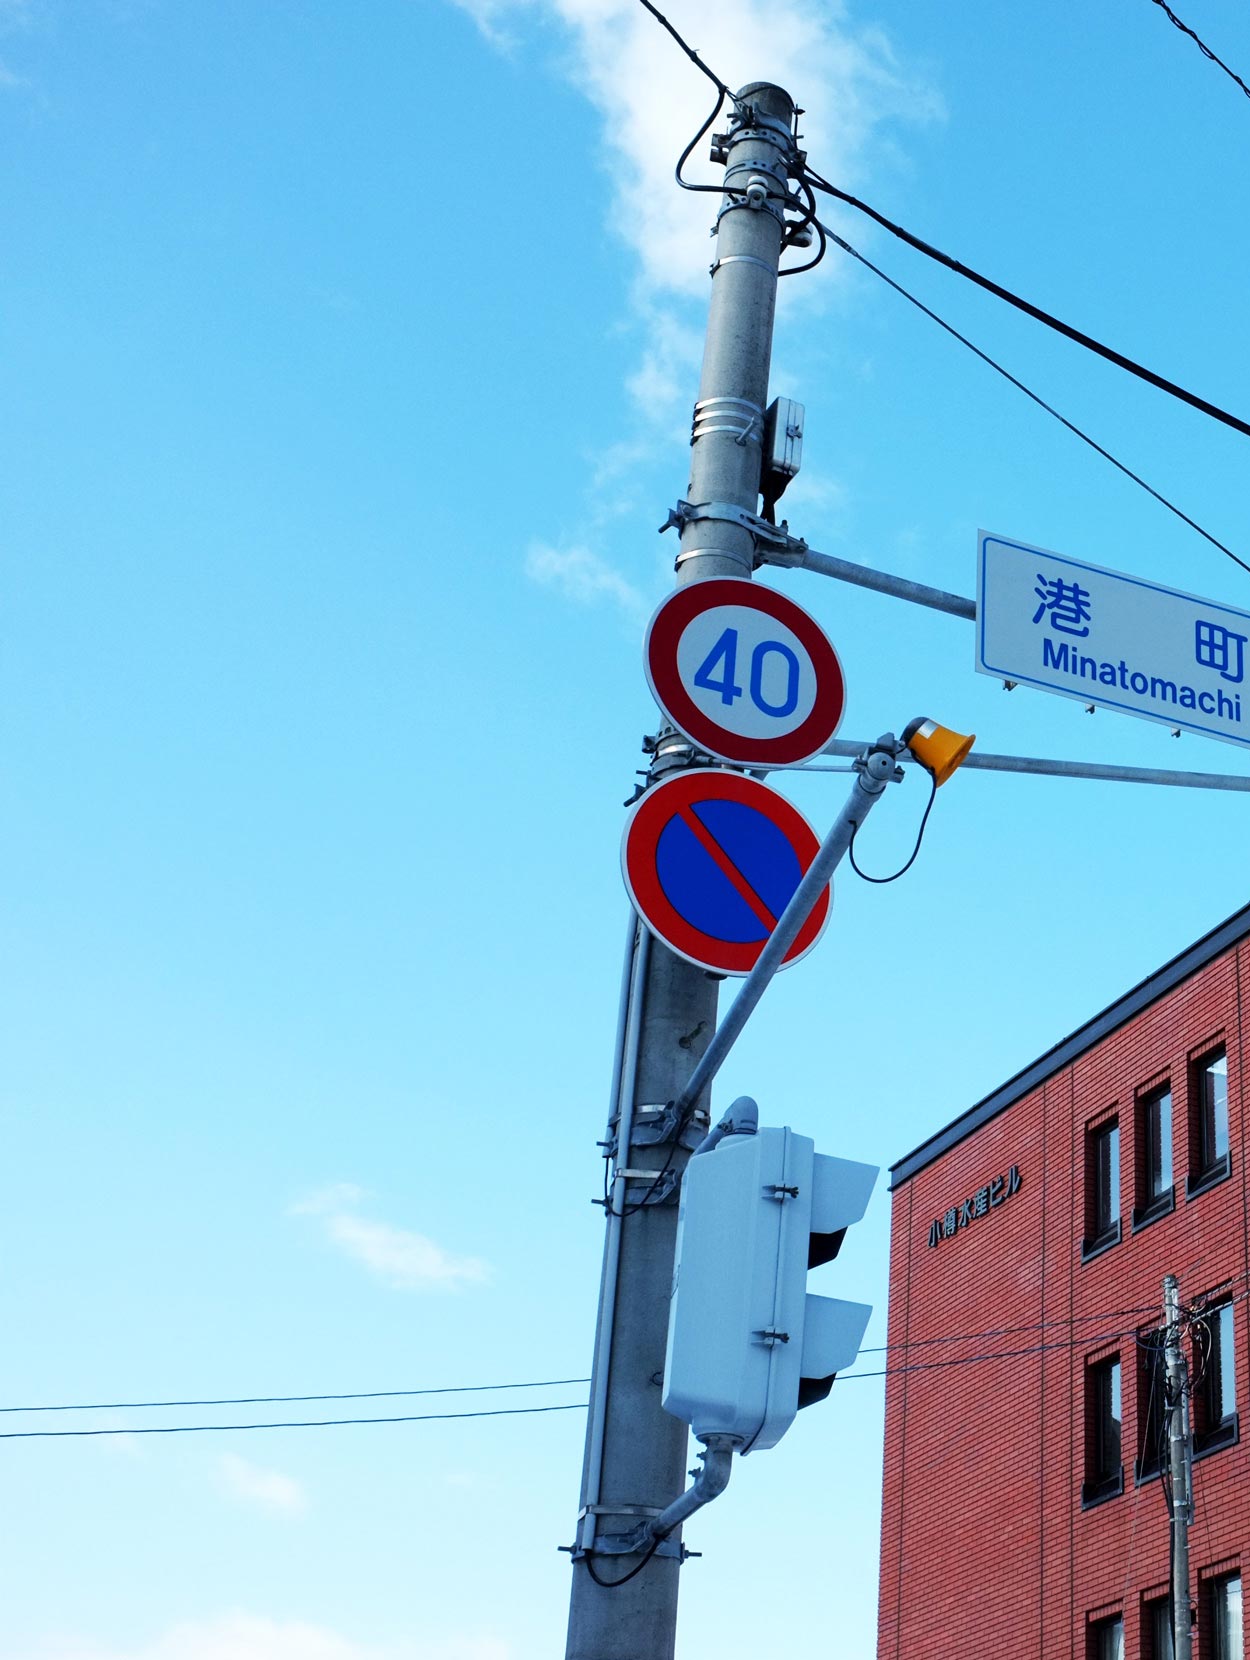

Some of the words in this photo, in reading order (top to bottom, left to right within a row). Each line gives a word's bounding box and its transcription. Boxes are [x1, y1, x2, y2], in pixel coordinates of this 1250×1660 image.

[693, 627, 800, 718] 40
[1043, 637, 1241, 723] Minatomachi
[928, 1164, 1023, 1247] 小樽水産ビル
